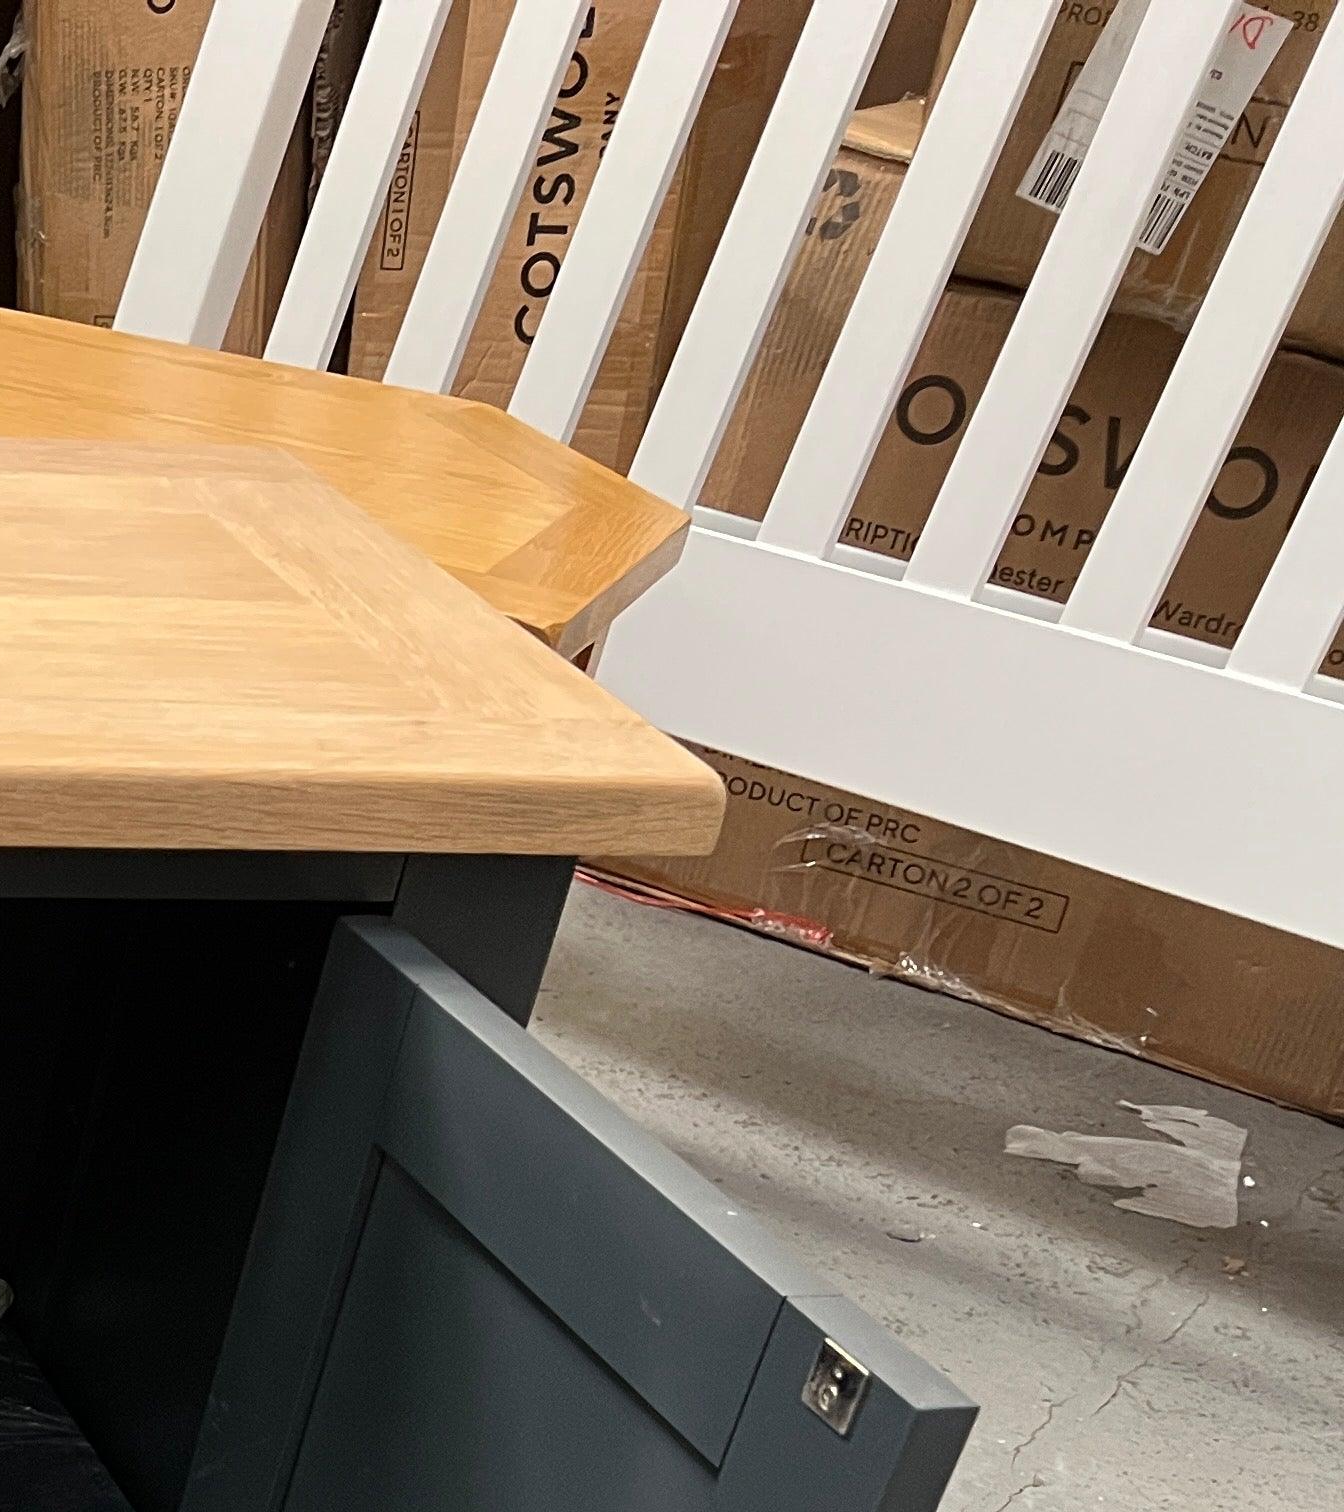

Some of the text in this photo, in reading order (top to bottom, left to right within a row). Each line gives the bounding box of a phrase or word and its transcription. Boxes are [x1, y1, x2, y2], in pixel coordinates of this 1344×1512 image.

[845, 517, 920, 553] RIPTI
[824, 802, 864, 828] OF
[865, 813, 921, 845] PRC
[825, 842, 1044, 919] CARTON 2 OF 2
